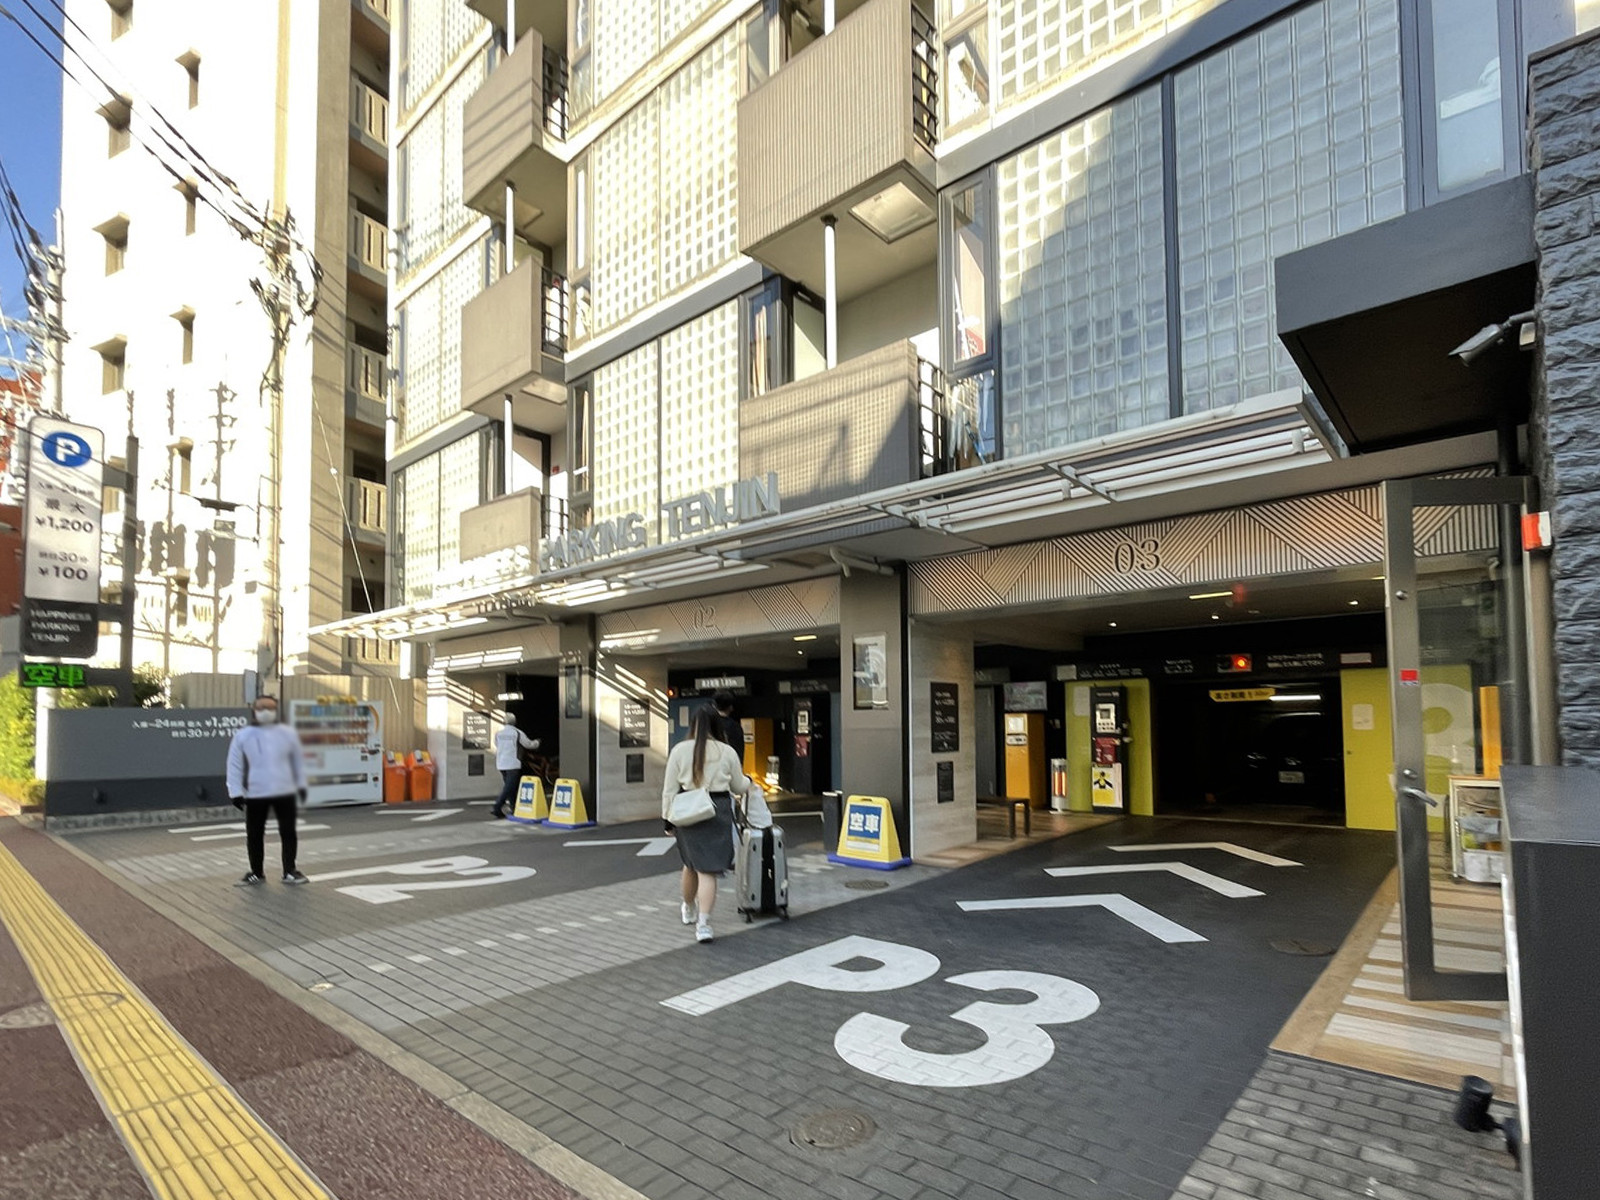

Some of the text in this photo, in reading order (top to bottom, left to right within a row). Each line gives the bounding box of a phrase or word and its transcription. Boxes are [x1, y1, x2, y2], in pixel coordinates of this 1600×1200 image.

[56, 437, 81, 462] P
[35, 515, 94, 534] ¥1,200
[539, 512, 647, 573] PARKING
[662, 472, 780, 537] TENJIN
[1113, 539, 1161, 575] 03
[38, 566, 89, 581] ¥100
[31, 621, 81, 633] PARKING
[694, 606, 715, 629] 02
[31, 632, 70, 643] TENJIN
[23, 663, 86, 687] 空車
[205, 716, 248, 729] ¥1,200
[849, 812, 880, 833] 空車
[306, 855, 537, 904] P2
[659, 934, 1101, 1087] P3
